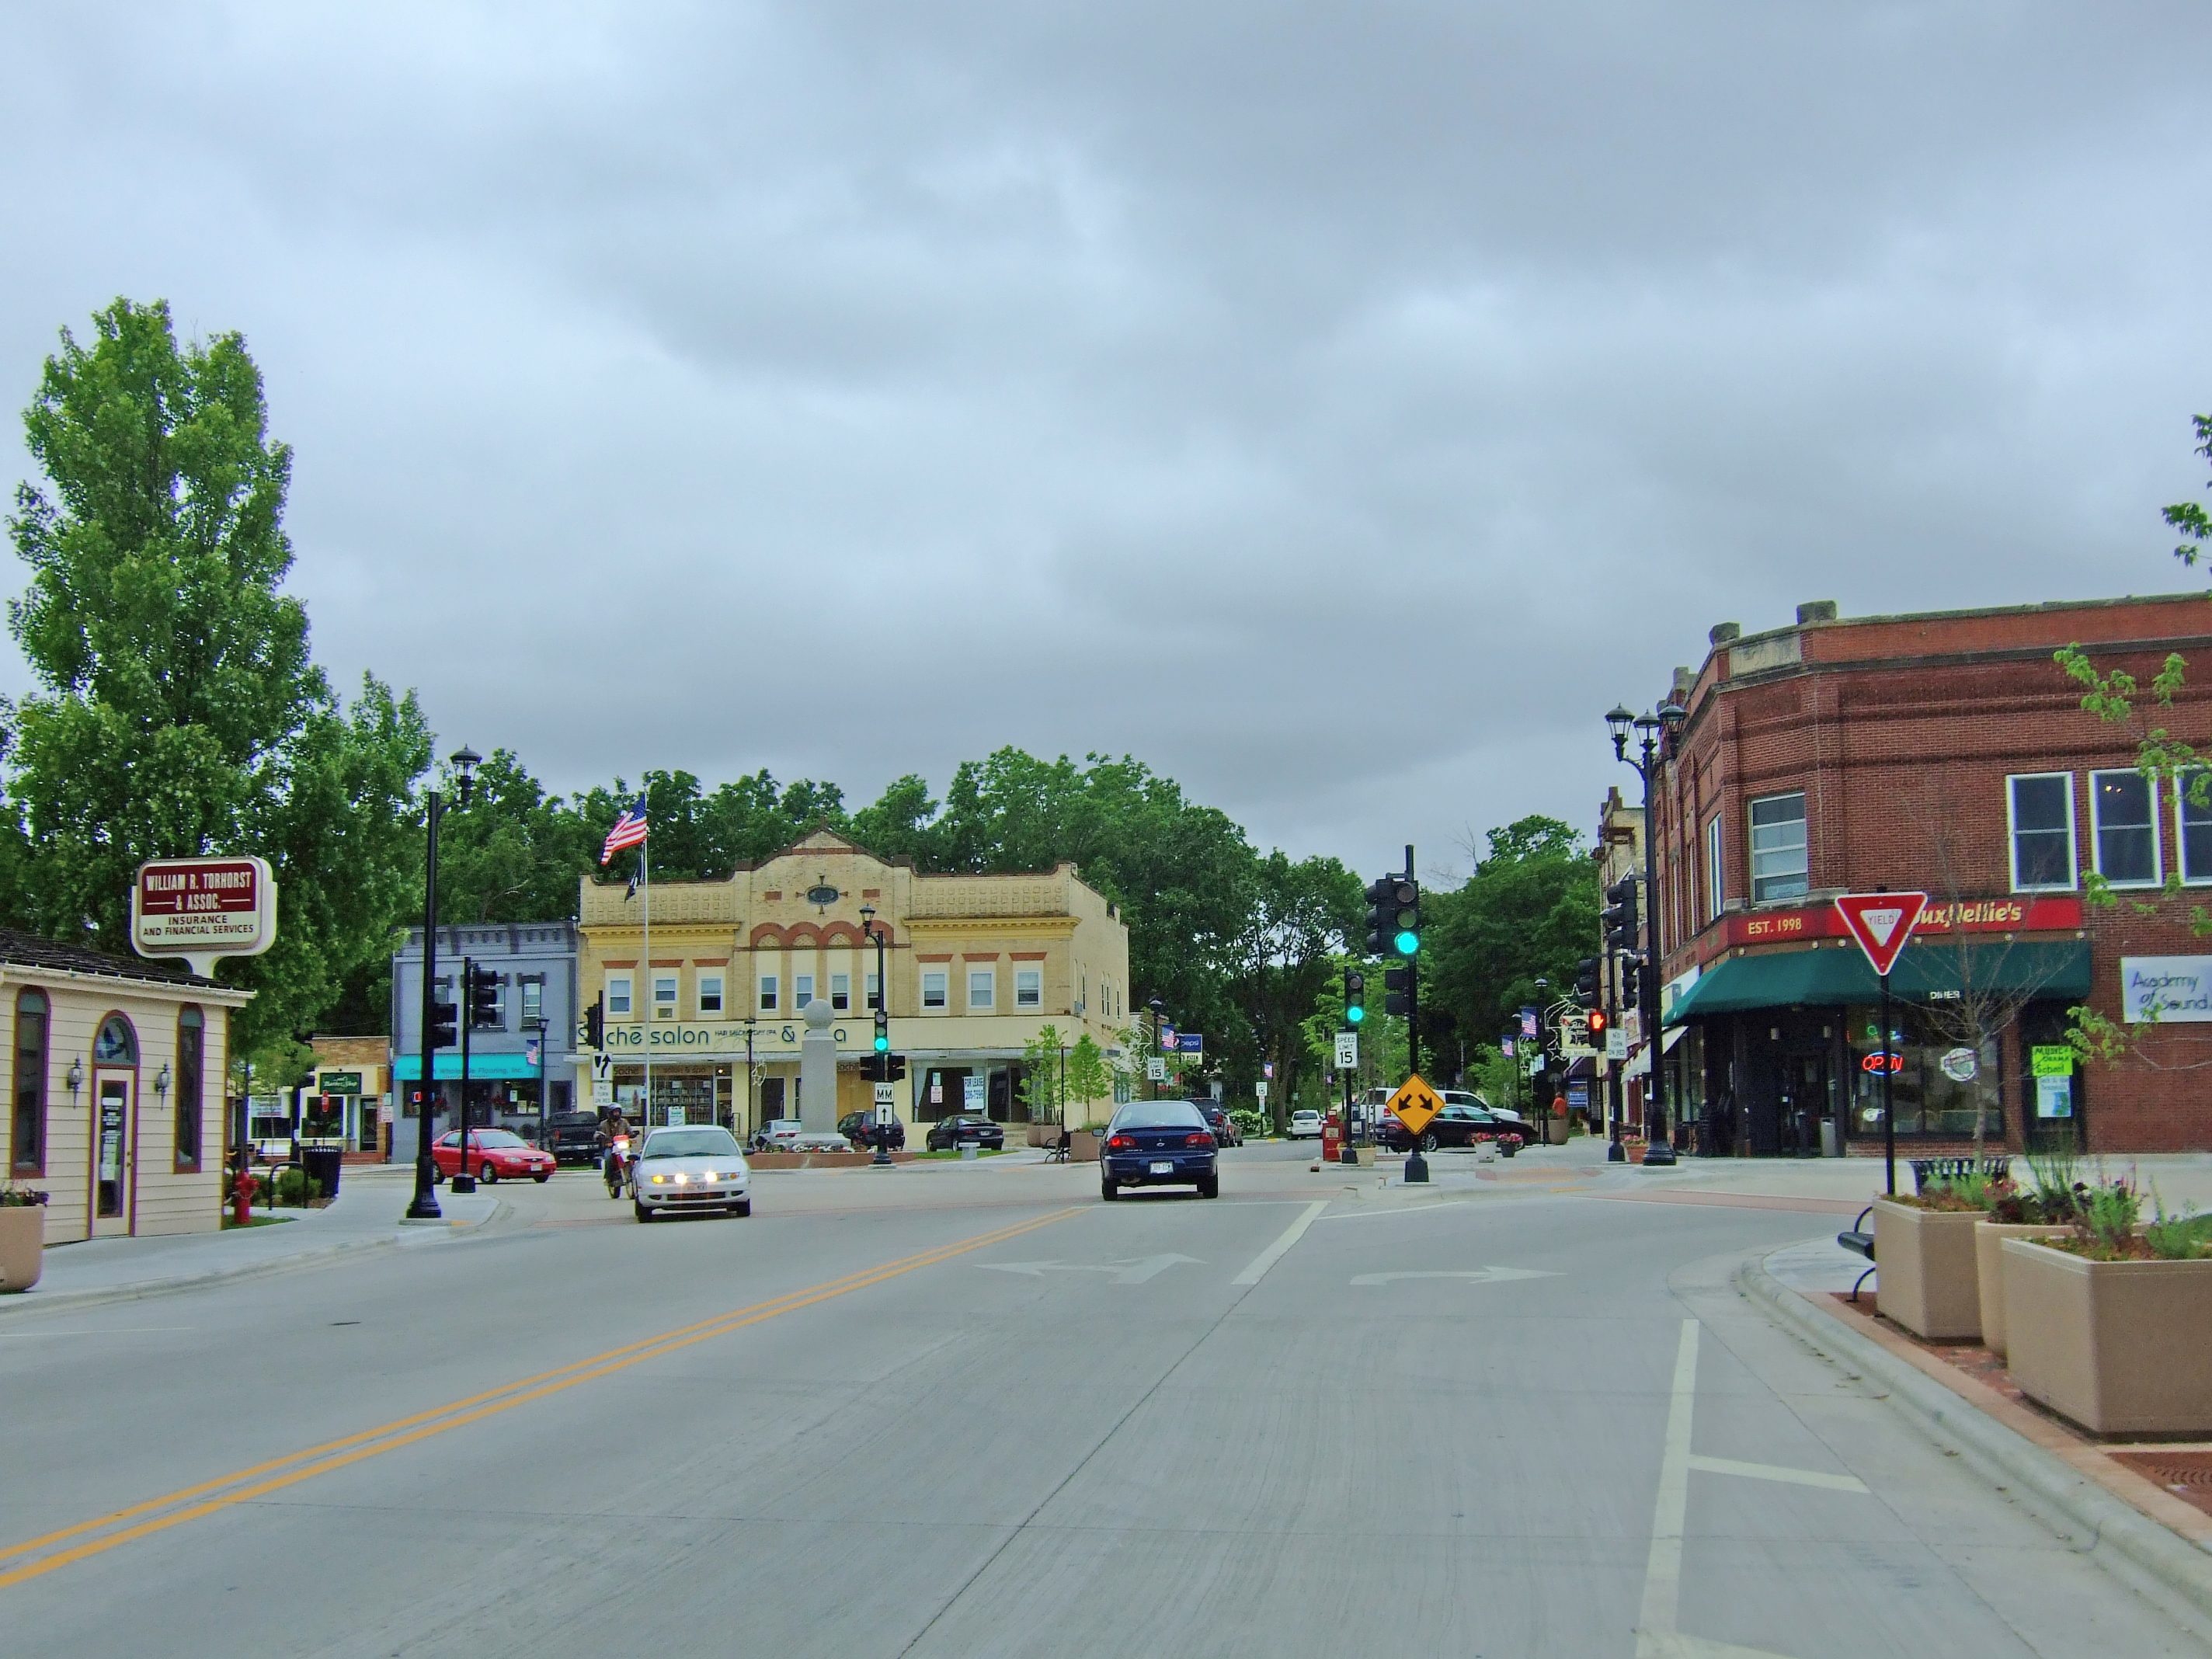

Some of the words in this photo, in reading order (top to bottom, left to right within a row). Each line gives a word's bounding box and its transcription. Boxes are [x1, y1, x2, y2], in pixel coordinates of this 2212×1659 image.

[146, 874, 186, 891] WILLIAM
[190, 874, 199, 889] R.
[203, 871, 252, 889] TORHORST
[176, 894, 183, 910] &
[186, 893, 221, 909] ASSOC.
[169, 915, 228, 925] INSURANCE
[1748, 921, 1774, 935] EST.
[1777, 917, 1802, 931] 1998
[1868, 915, 1894, 925] YIELD
[165, 927, 209, 935] FINANCIAL
[214, 925, 254, 934] SERVICES
[2132, 971, 2199, 993] Academy
[2139, 987, 2159, 1007] of
[650, 1025, 709, 1044] salon
[781, 1025, 795, 1042] &
[1340, 1051, 1353, 1064] 15
[1862, 1056, 1904, 1071] OPN
[1151, 1069, 1161, 1077] 15
[877, 1089, 892, 1100] MM
